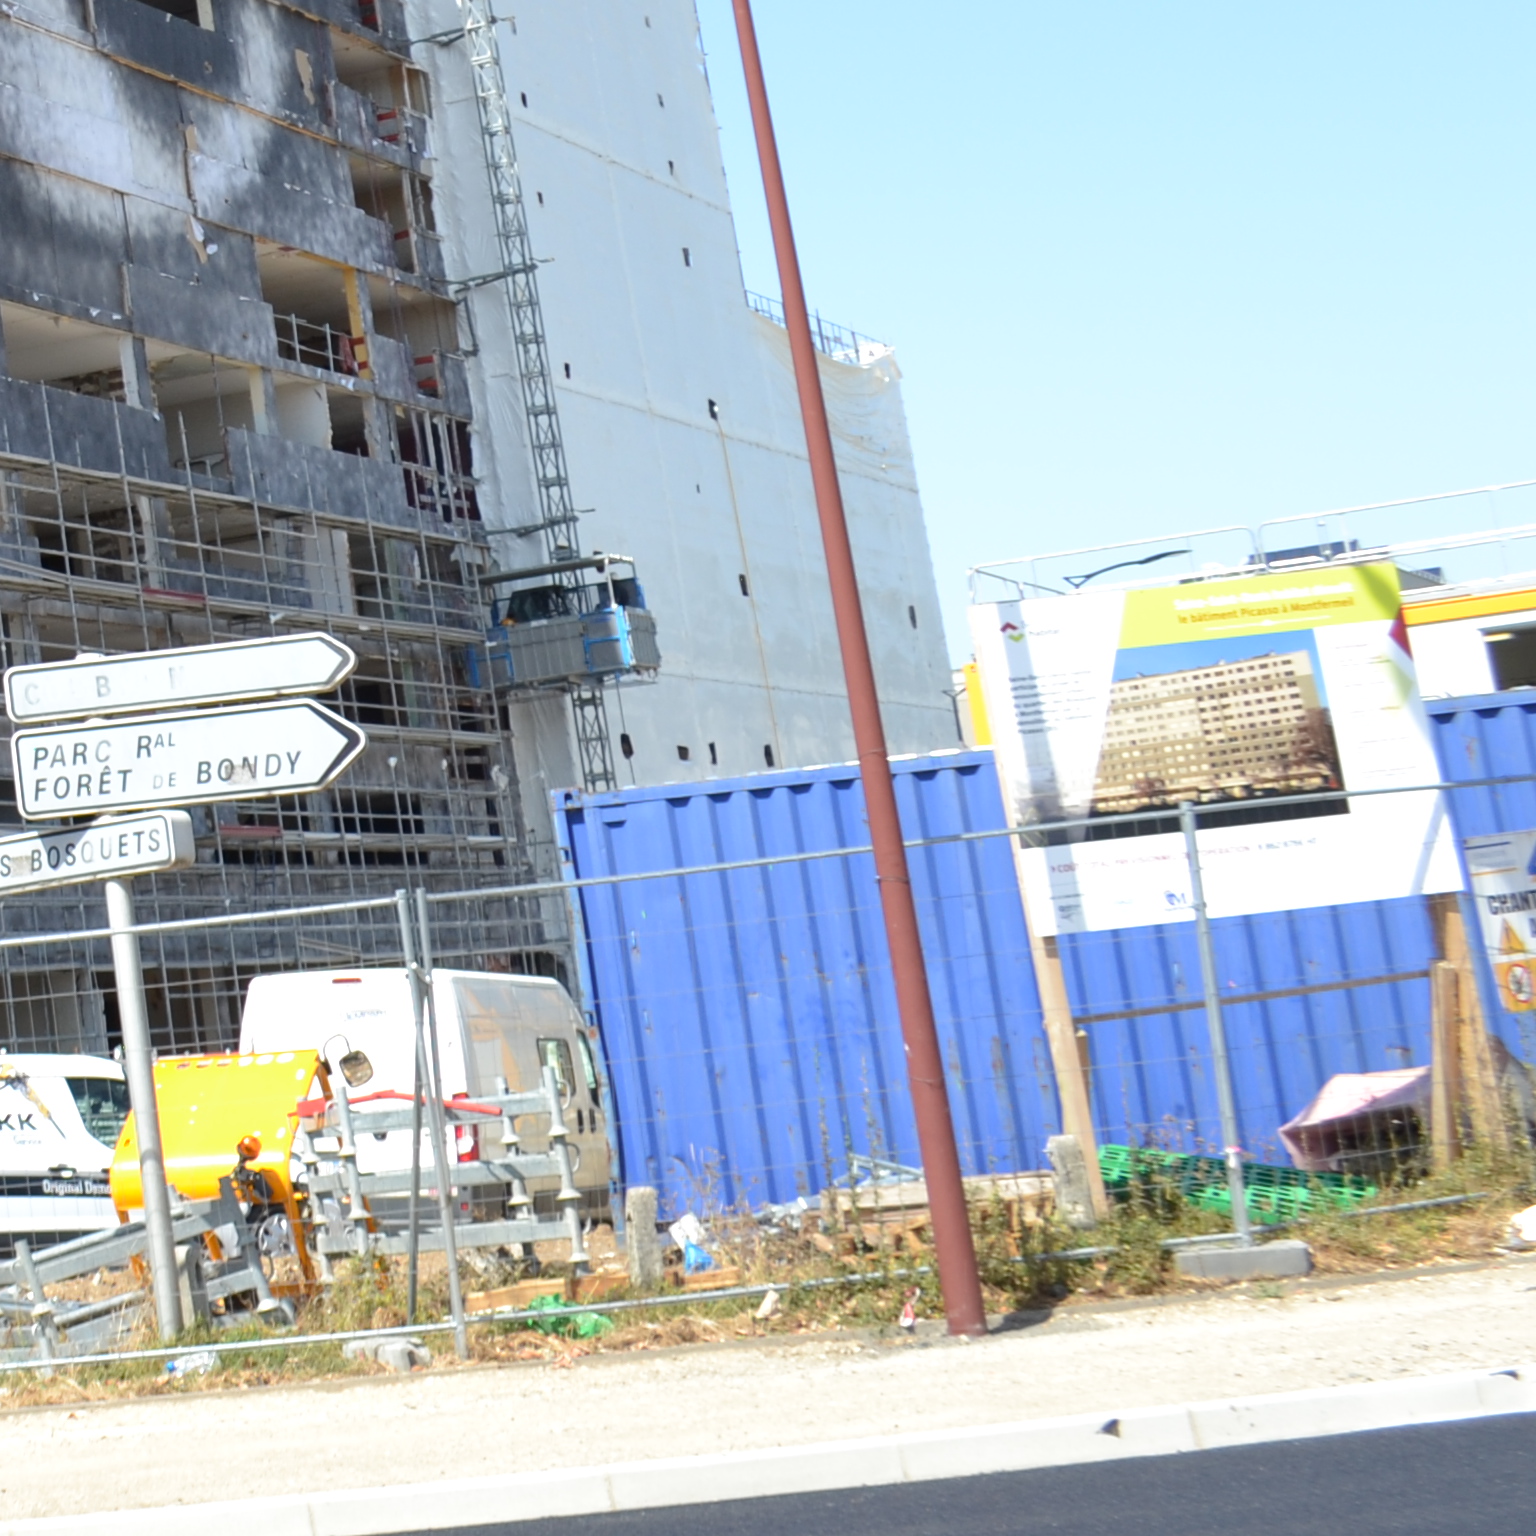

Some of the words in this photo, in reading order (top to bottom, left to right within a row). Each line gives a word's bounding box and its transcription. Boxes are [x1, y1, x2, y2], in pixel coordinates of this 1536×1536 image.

[1190, 609, 1238, 623] bâtiment
[1241, 605, 1278, 617] Picasso
[1282, 602, 1288, 613] à
[1290, 596, 1355, 613] Montfermeil
[33, 740, 112, 770] PARC
[34, 765, 132, 802] FORÊT
[152, 772, 177, 789] DE
[196, 750, 302, 785] BONDY
[31, 829, 160, 873] BOSQUETS
[42, 1178, 83, 1196] Original
